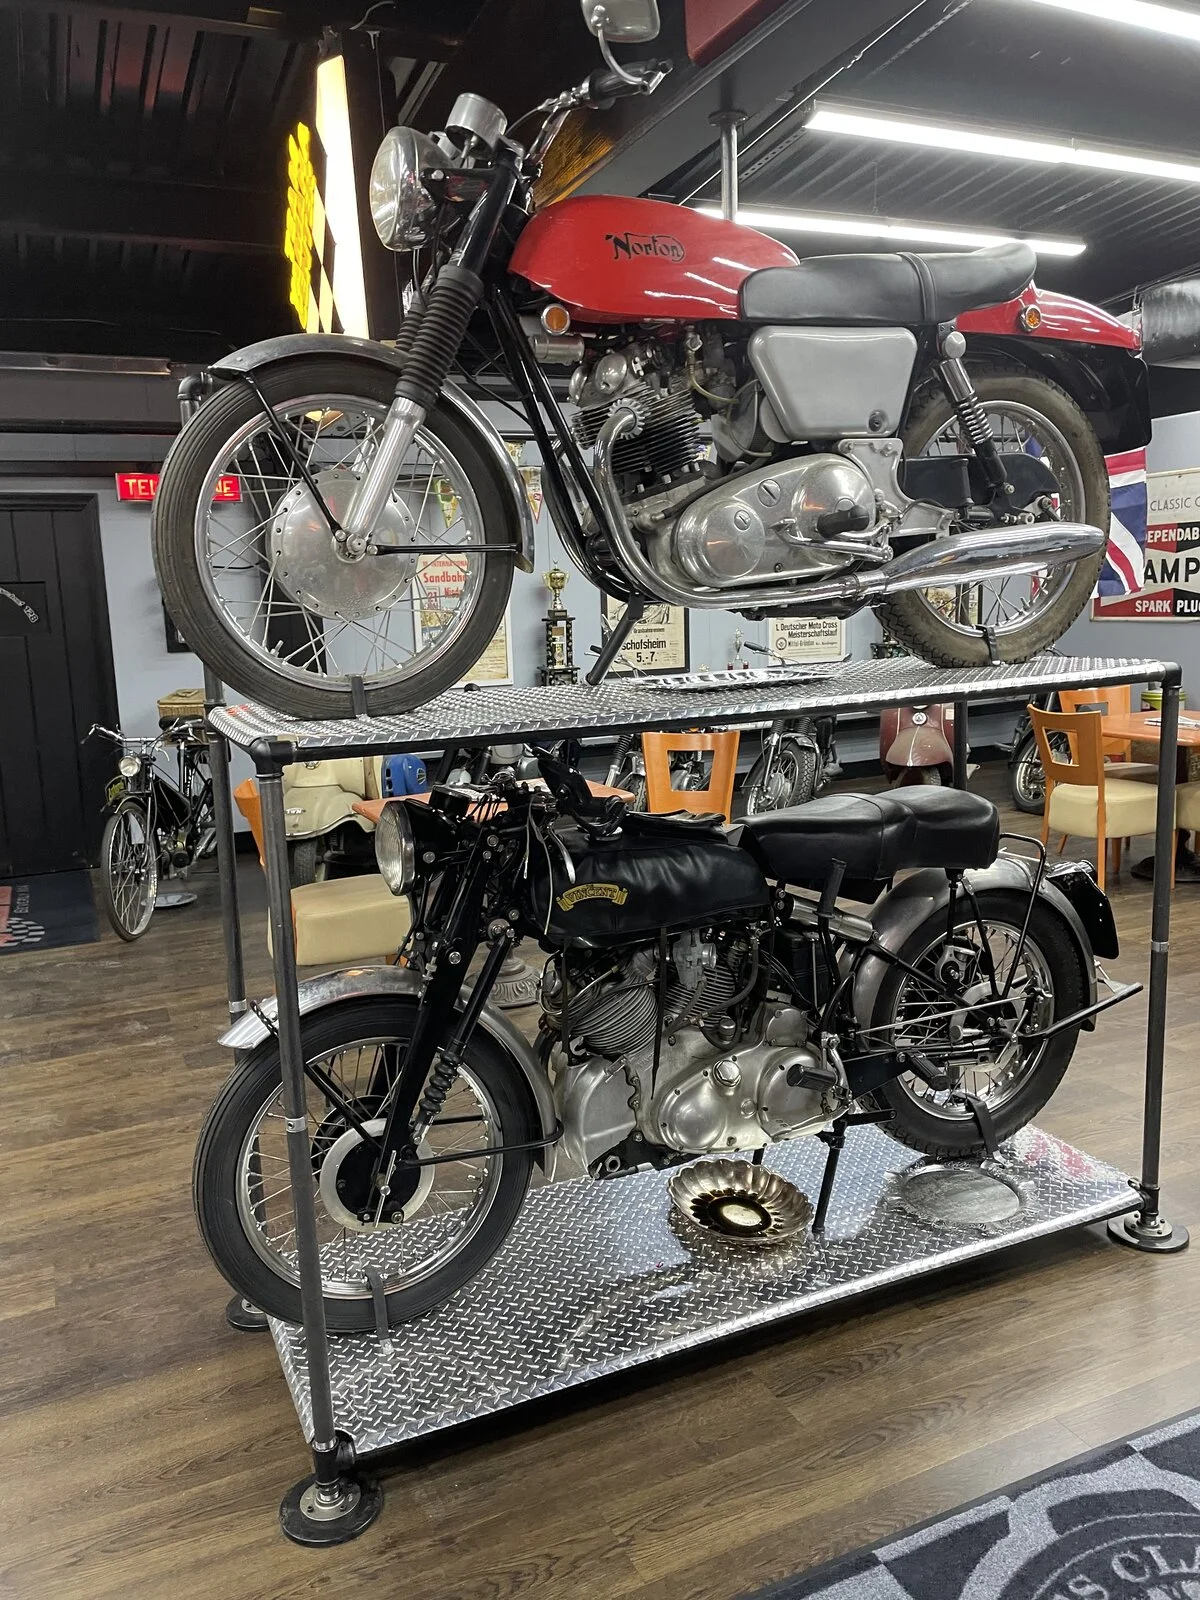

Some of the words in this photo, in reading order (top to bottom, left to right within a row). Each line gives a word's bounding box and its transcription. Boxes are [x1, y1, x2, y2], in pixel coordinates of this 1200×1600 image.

[605, 232, 685, 262] Norton
[1150, 497, 1191, 512] CLASSIC
[1135, 600, 1171, 613] SPARK
[1176, 600, 1200, 613] PLU
[24, 606, 38, 623] 128
[781, 622, 807, 631] Deutscher
[808, 621, 821, 630] Moto
[822, 621, 838, 629] Cross
[788, 628, 838, 639] Meisterschaftslauf
[565, 886, 617, 901] VINCENT
